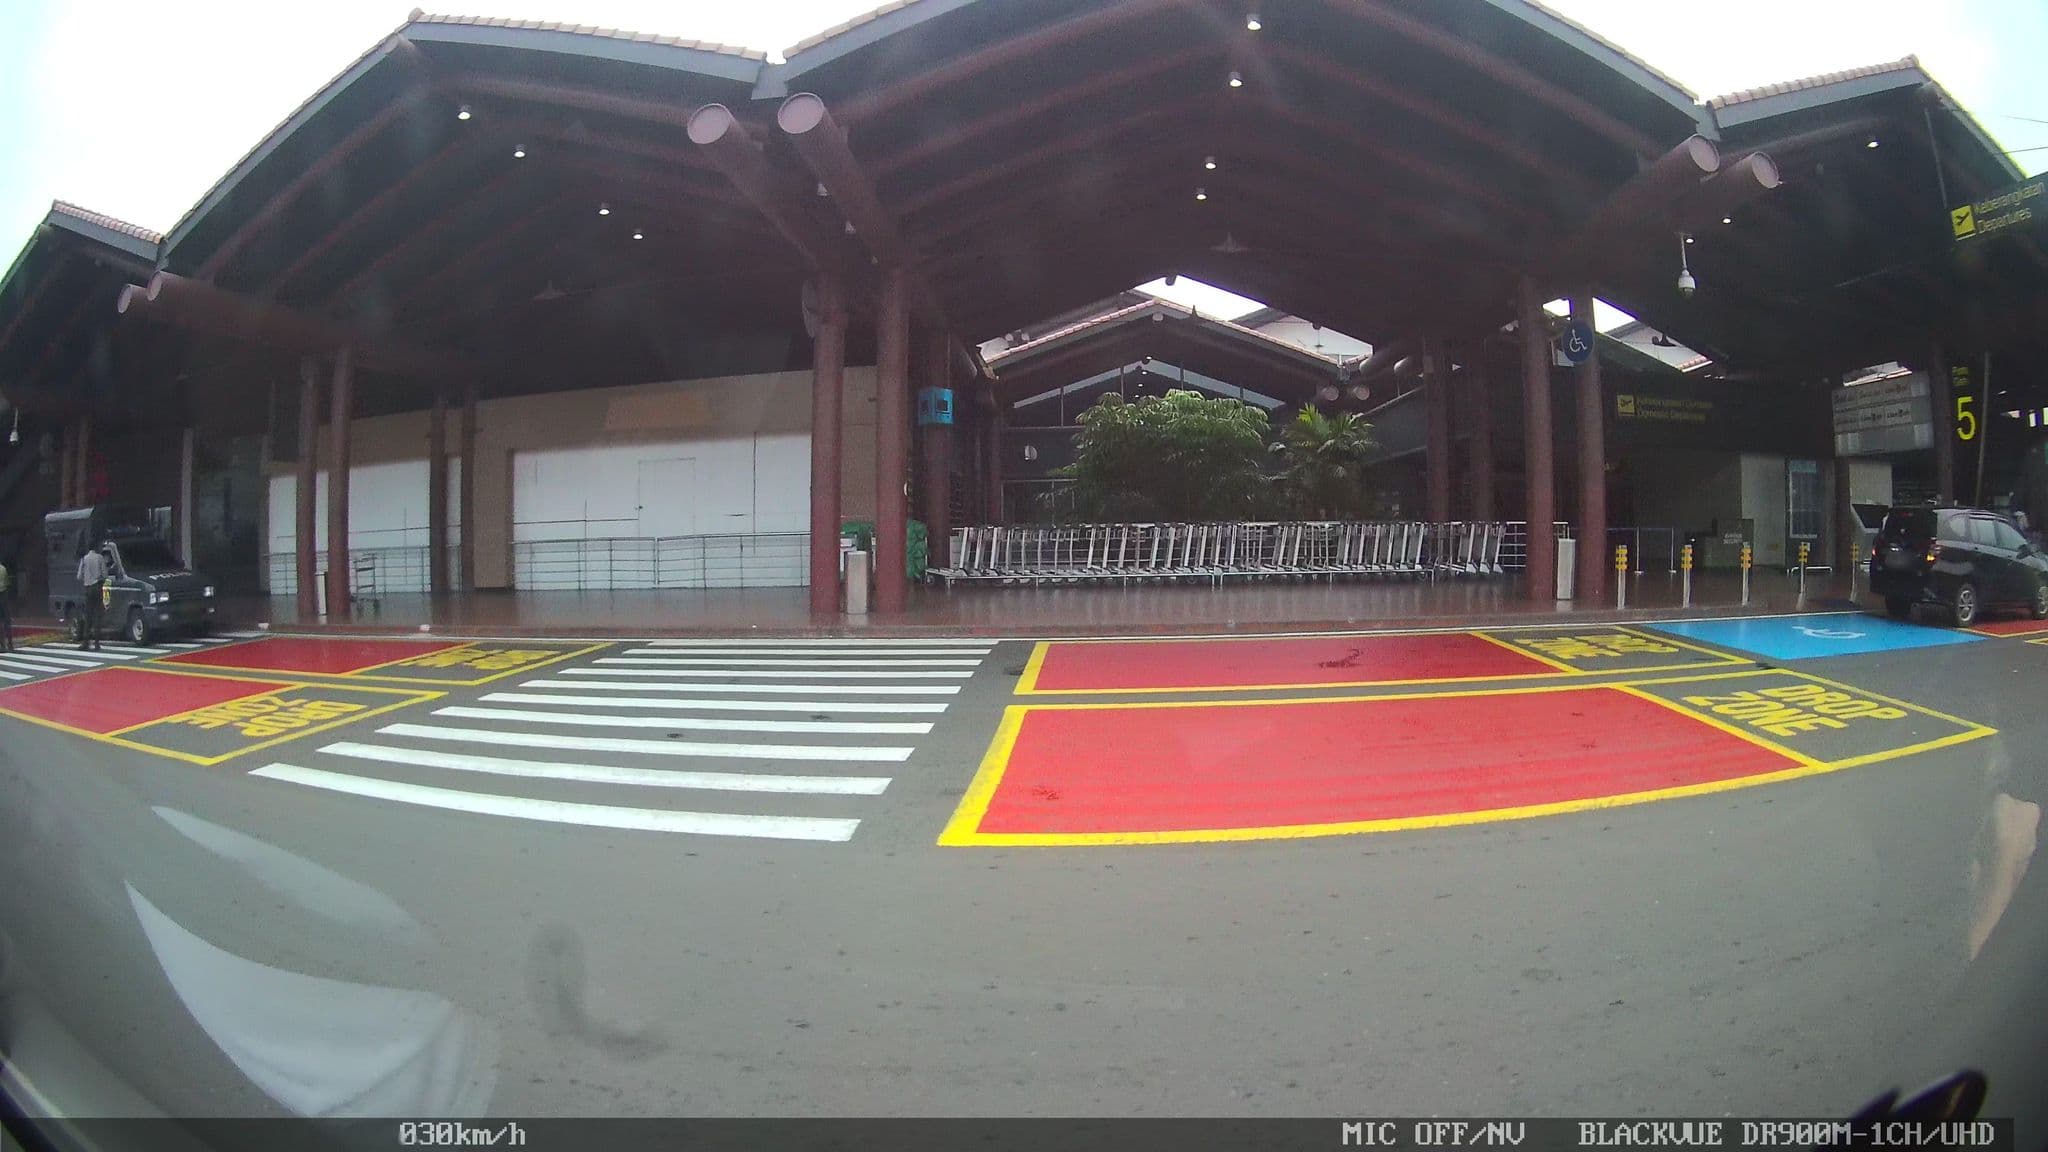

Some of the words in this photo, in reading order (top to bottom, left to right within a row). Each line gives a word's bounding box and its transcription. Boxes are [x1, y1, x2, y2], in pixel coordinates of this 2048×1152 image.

[1977, 208, 2032, 234] Departures
[1957, 396, 1976, 440] 5
[233, 700, 368, 737] DROP
[1683, 691, 1850, 737] ZONE
[1757, 684, 1908, 720] DROP
